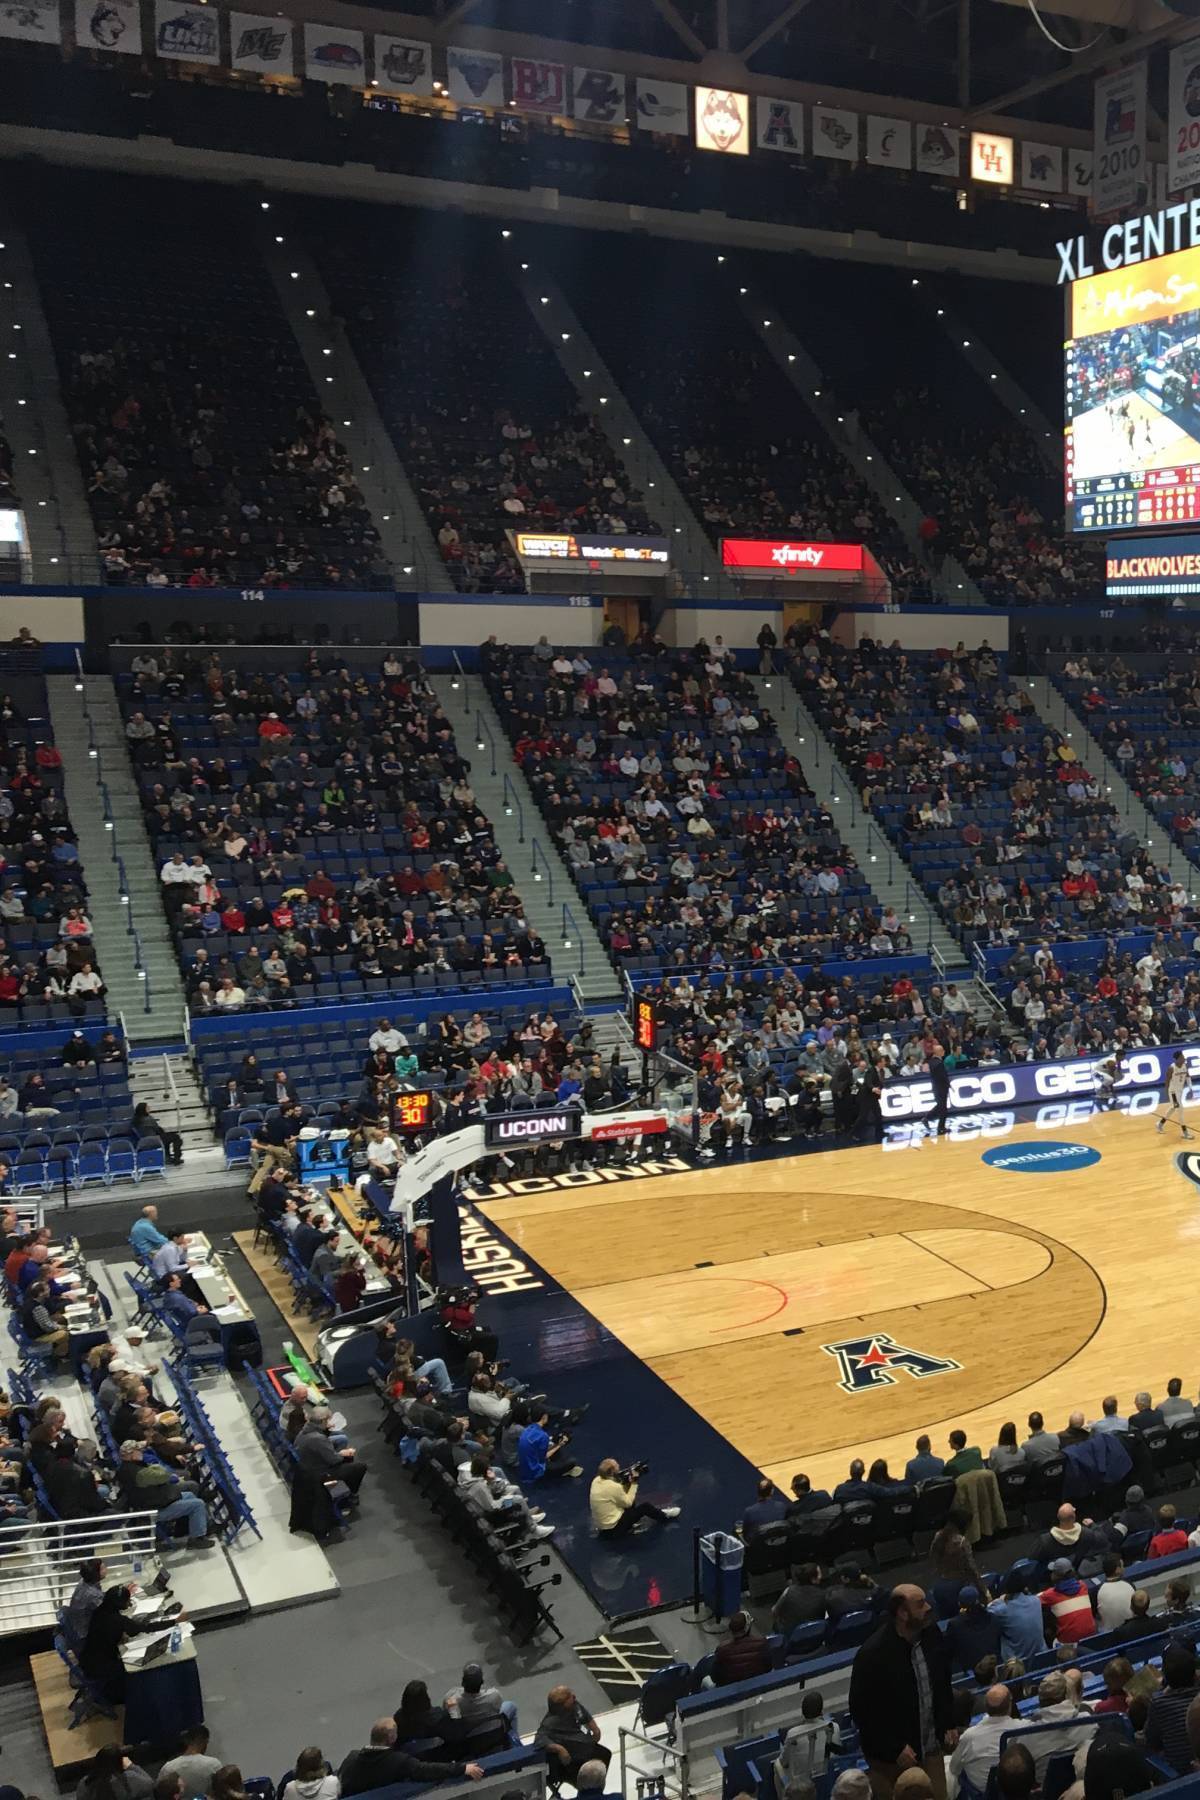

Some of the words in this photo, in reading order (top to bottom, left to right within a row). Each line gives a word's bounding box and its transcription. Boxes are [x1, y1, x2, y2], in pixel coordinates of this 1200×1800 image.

[978, 143, 1003, 173] UH
[1099, 144, 1140, 179] 2010
[1056, 235, 1095, 285] XL
[771, 544, 824, 566] xfinity
[240, 590, 264, 601] 114
[569, 596, 591, 607] 115
[883, 604, 900, 613] 116
[1099, 609, 1115, 618] 117
[1035, 1054, 1161, 1096] GECO
[879, 1073, 1016, 1117] GECO
[401, 1110, 421, 1124] 30
[499, 1116, 567, 1138] UCONN
[991, 1146, 1090, 1168] genius3D
[462, 1158, 691, 1200] UCONN
